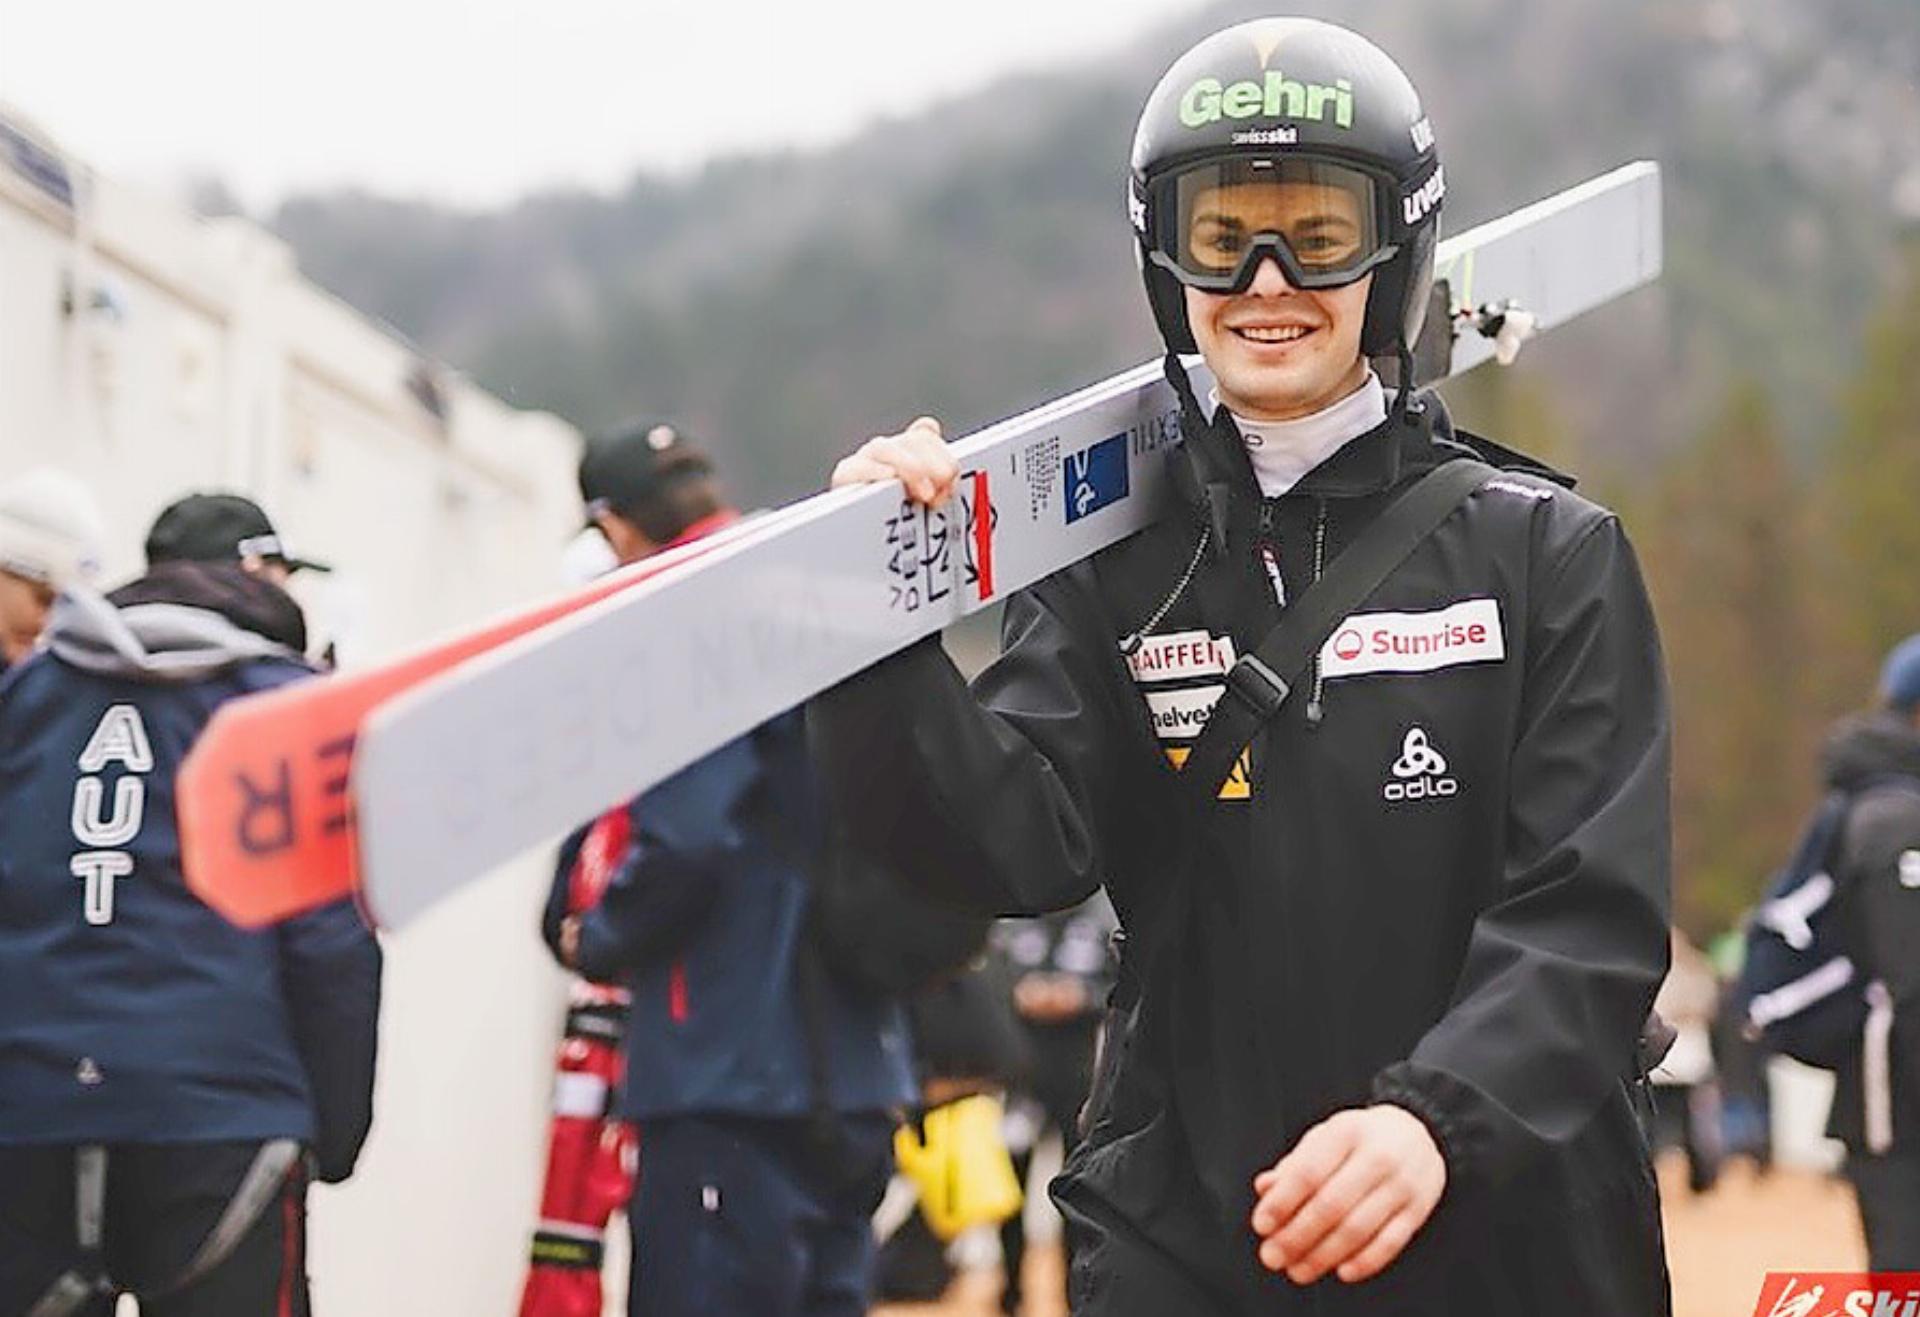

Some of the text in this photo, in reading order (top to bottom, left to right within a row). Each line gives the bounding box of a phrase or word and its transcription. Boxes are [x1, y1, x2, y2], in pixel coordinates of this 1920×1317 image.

[1179, 70, 1353, 128] Gehri
[1371, 621, 1487, 656] Sunrise
[1384, 774, 1458, 800] odlo
[70, 704, 153, 925] AUT
